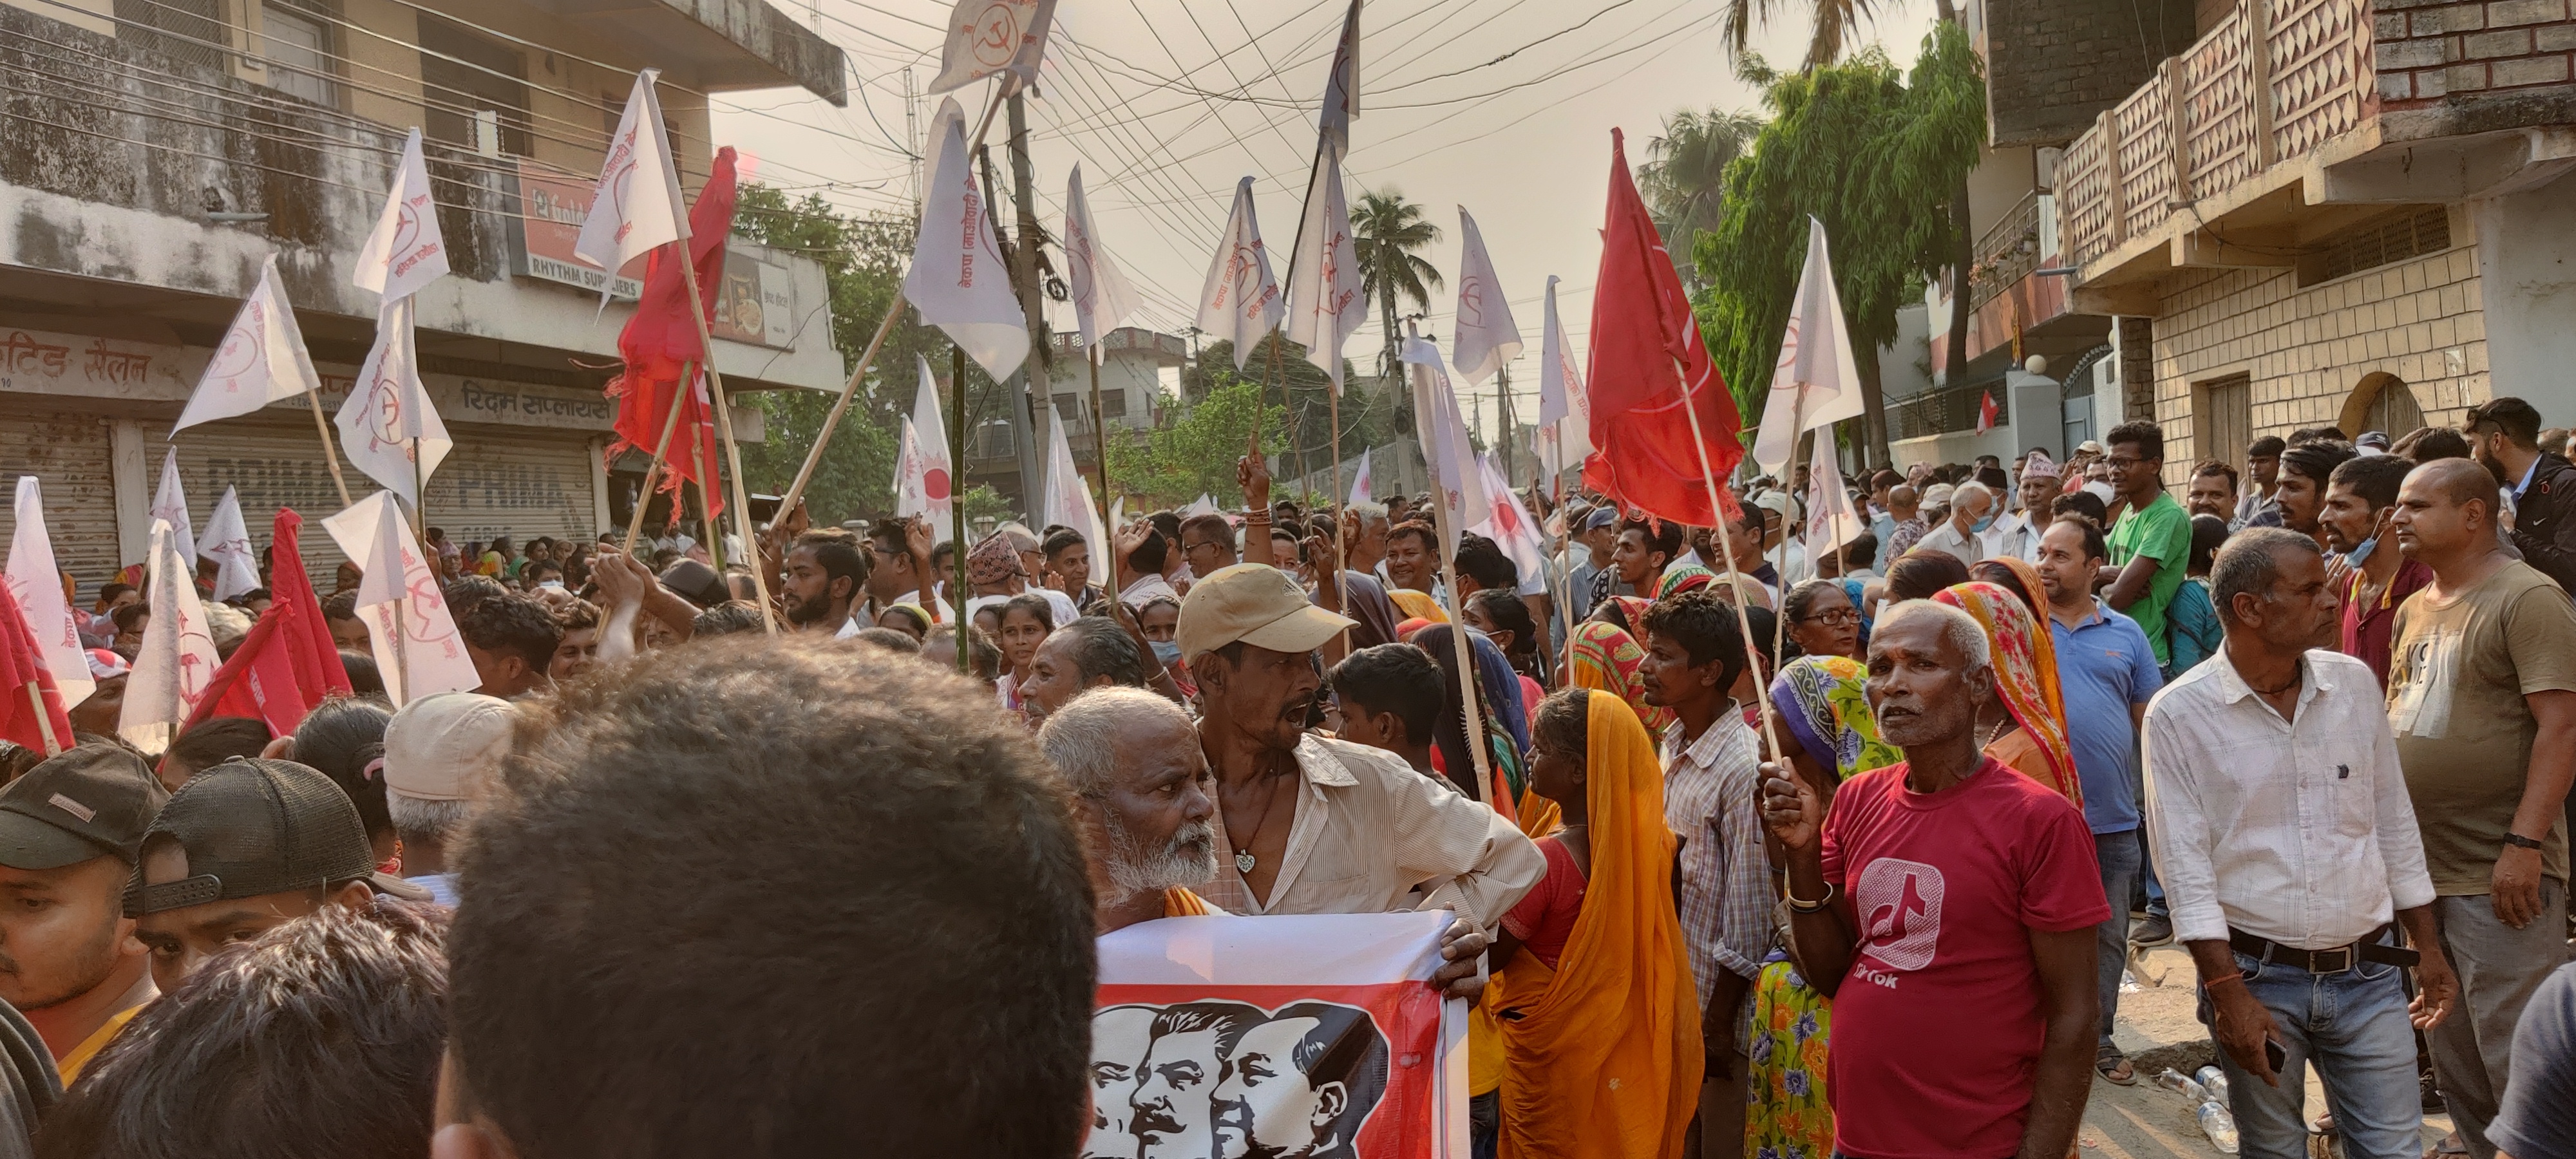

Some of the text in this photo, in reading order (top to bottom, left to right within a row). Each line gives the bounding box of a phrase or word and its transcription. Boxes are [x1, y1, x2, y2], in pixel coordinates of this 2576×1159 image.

[533, 259, 636, 296] RHYTHM SUPIERS
[458, 462, 565, 509] PRIMA
